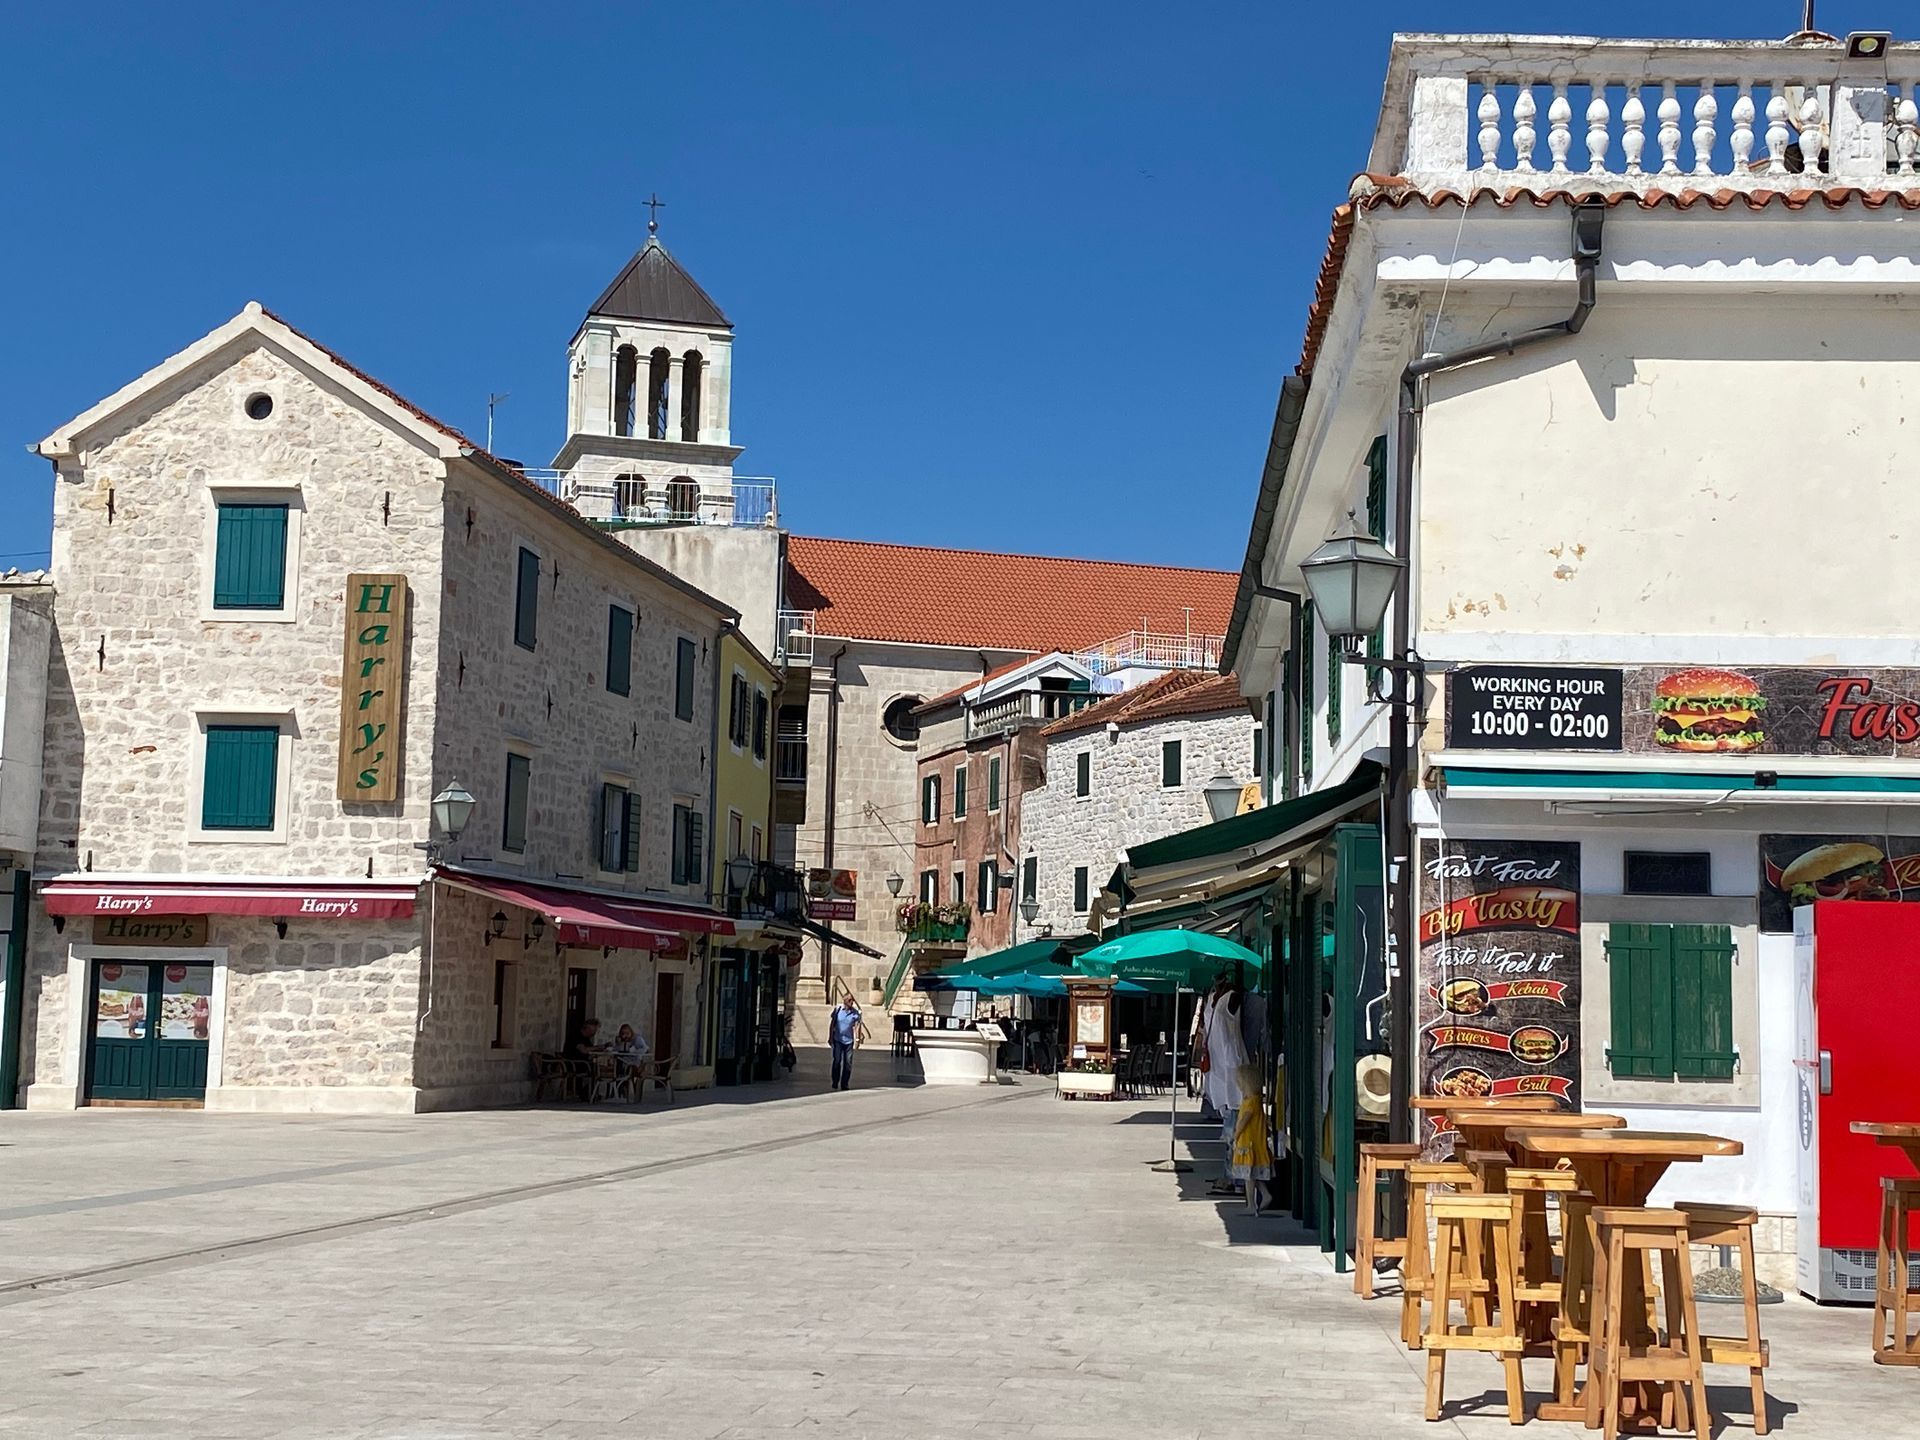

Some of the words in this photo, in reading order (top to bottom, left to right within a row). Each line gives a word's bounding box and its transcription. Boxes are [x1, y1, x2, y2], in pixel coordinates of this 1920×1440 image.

[353, 583, 397, 790] Harry's
[1471, 677, 1551, 694] WORKING
[1556, 680, 1605, 695] HOUR
[1493, 695, 1545, 711] EVERY
[1550, 697, 1583, 712] DAY
[1471, 711, 1529, 736] 10:00
[1550, 713, 1609, 738] 02:00
[1424, 855, 1499, 880] Fast
[1491, 860, 1561, 882] Food
[96, 895, 153, 913] Harry's
[301, 898, 358, 917] Harry's
[836, 904, 854, 913] PIZZA
[1424, 908, 1465, 936] Big
[1469, 890, 1563, 928] Tasty
[106, 917, 195, 942] Harry's
[1432, 946, 1477, 967] Taste
[1481, 945, 1505, 965] it
[1494, 951, 1536, 974] Feel
[1538, 951, 1564, 971] it
[1505, 982, 1549, 996] Kebab
[1443, 1030, 1490, 1045] Burgers
[1517, 1078, 1550, 1092] Grill
